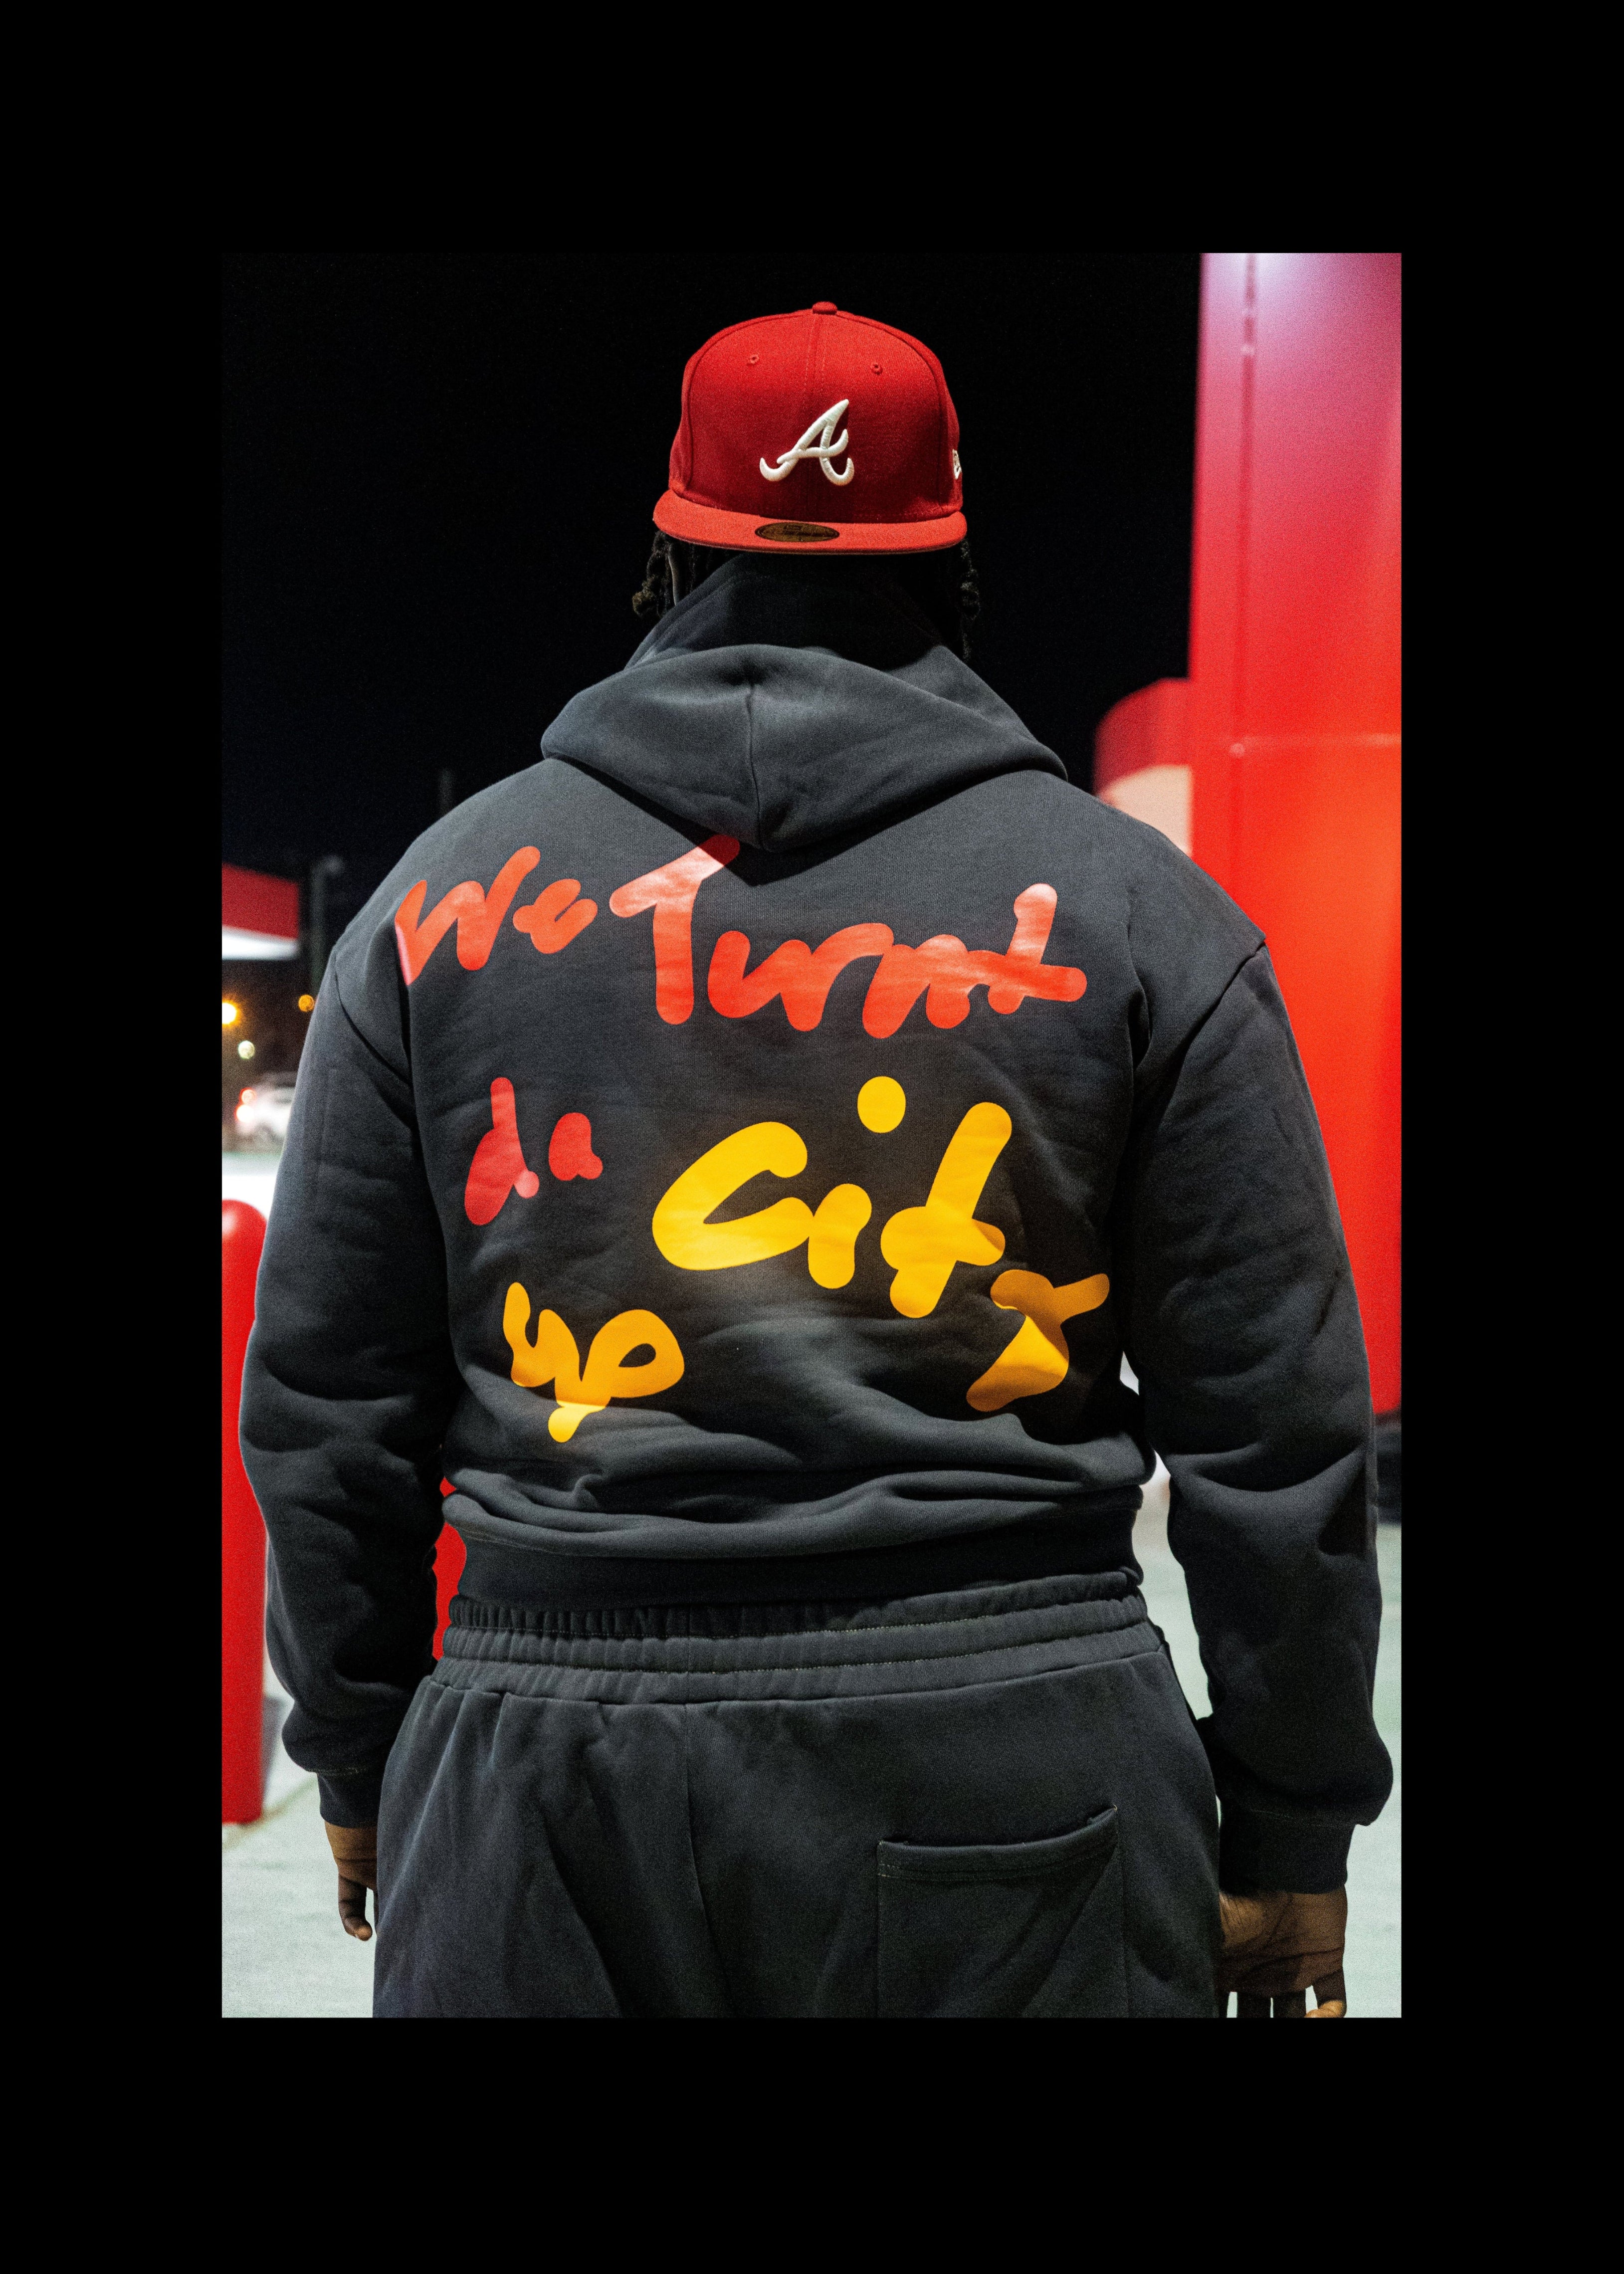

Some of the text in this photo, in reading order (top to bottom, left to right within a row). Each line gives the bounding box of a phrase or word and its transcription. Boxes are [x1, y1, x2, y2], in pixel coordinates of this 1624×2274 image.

[759, 398, 855, 486] A
[395, 835, 1088, 1039] We Turnt
[464, 1076, 604, 1226] da
[502, 1282, 685, 1444] up
